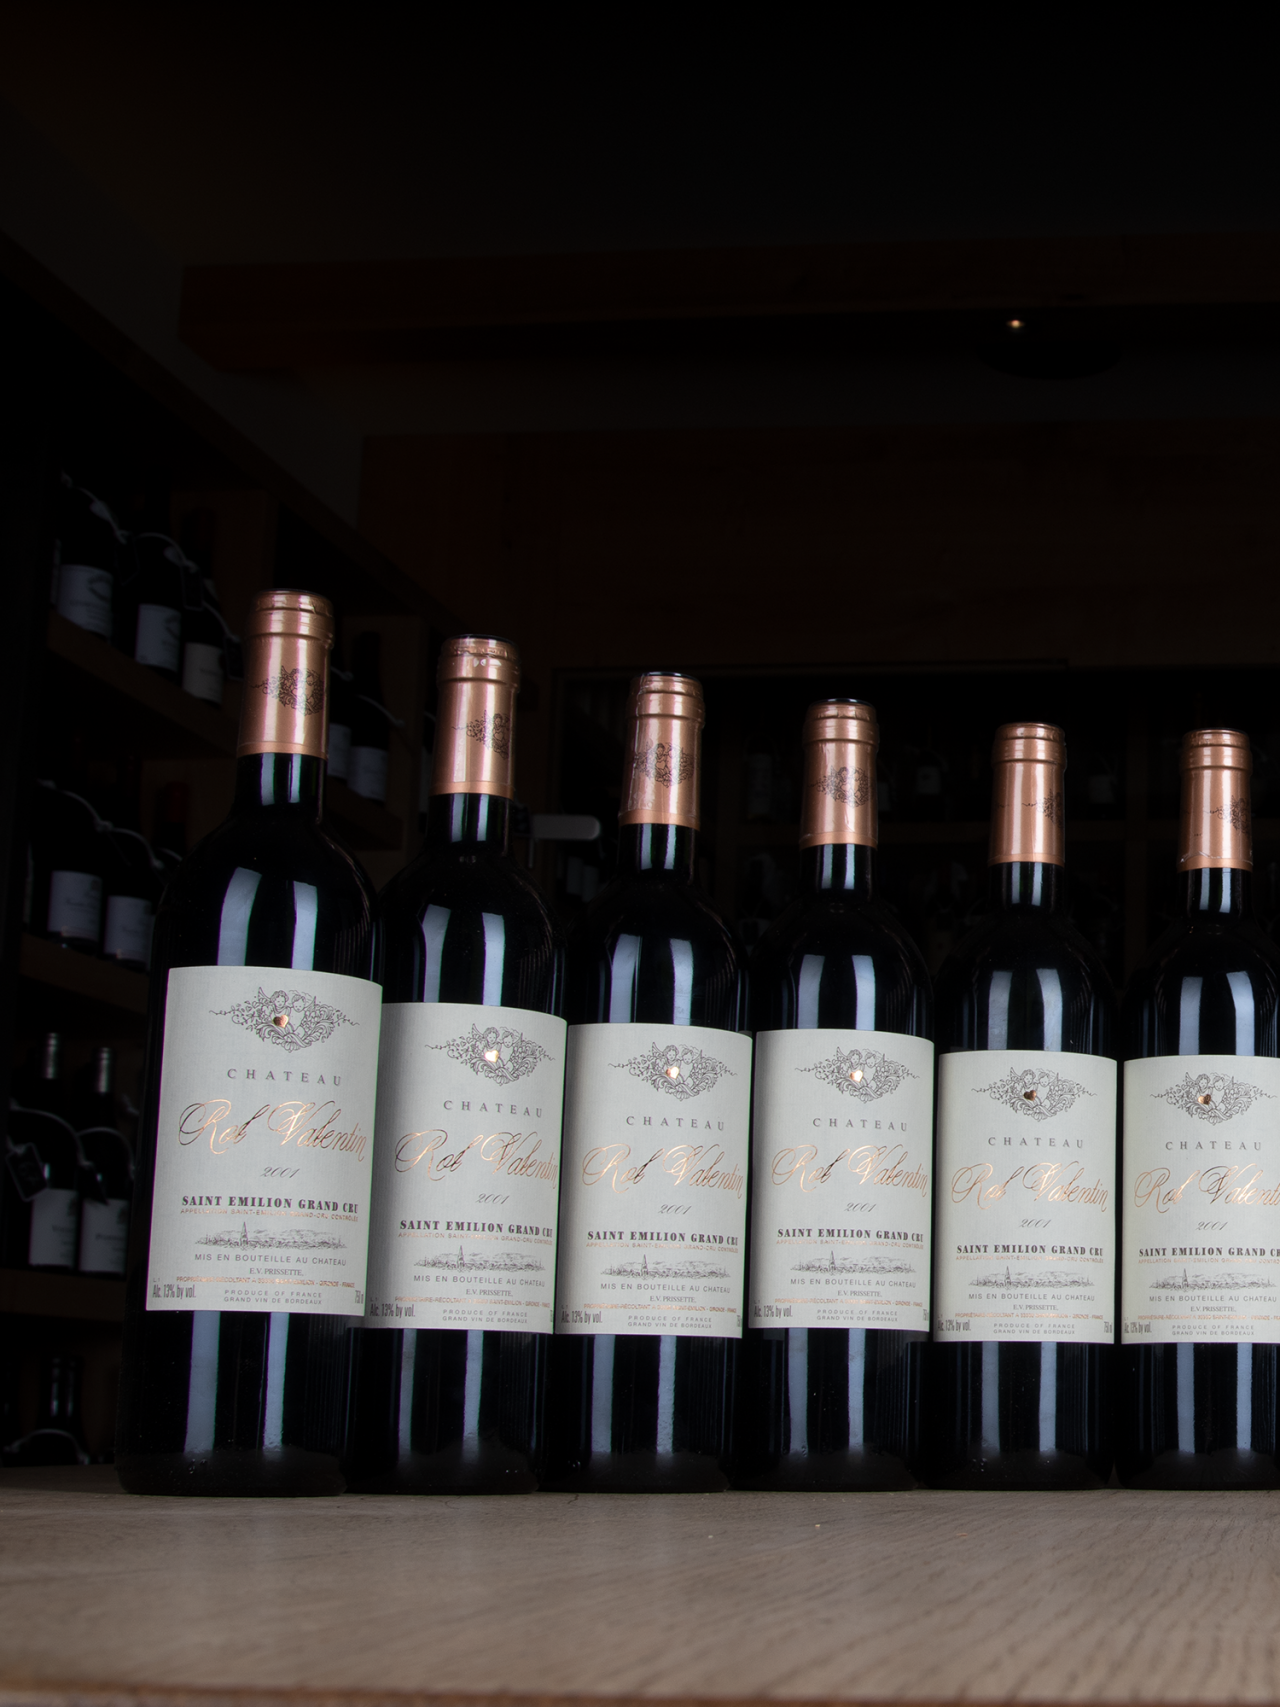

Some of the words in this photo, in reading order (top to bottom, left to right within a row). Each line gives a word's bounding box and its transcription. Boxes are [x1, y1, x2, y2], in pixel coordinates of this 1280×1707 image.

[227, 1068, 342, 1087] CHATEAU
[443, 1100, 542, 1118] CHATEAU
[626, 1116, 724, 1131] CHATEAU
[812, 1118, 908, 1132] CHATEAU
[267, 1100, 367, 1162] Valentin
[988, 1137, 1083, 1148] CHATEAU
[1165, 1141, 1261, 1151] CHATEAU
[480, 1131, 558, 1189] Valentin
[260, 1166, 300, 1179] 2001
[662, 1144, 744, 1199] Valentin
[848, 1144, 928, 1198] Valentin
[1023, 1161, 1109, 1212] Valentin
[182, 1196, 222, 1206] SAINT
[228, 1196, 293, 1208] EMILION
[298, 1199, 339, 1212] GRAND
[475, 1193, 510, 1205] 2001
[658, 1204, 692, 1215] 2001
[843, 1203, 877, 1212] 2001
[400, 1220, 440, 1230] SAINT
[446, 1221, 503, 1233] EMILION
[508, 1224, 540, 1236] GRAND
[1018, 1219, 1051, 1228] 2001
[1195, 1222, 1228, 1231] 2001
[587, 1231, 624, 1240] SAINT
[630, 1231, 686, 1242] EMILION
[691, 1234, 724, 1244] GRAND
[777, 1228, 812, 1238] SAINT
[818, 1229, 871, 1239] EMILION
[876, 1231, 908, 1241] GRAND
[956, 1245, 988, 1253] SAINT
[994, 1245, 1046, 1254] EMILION
[1051, 1245, 1086, 1255] GRAND
[1139, 1248, 1167, 1258] SAINT
[1172, 1248, 1222, 1256] EMILION
[1228, 1248, 1266, 1257] GRAND
[195, 1253, 212, 1261] MIS
[235, 1254, 291, 1263] BOUTEILLE
[296, 1256, 308, 1264] AU
[312, 1257, 346, 1266] CHATEAU
[452, 1276, 503, 1285] BOUTEILLE
[520, 1279, 545, 1287] CHATEAU
[152, 1285, 162, 1299] Alc.
[163, 1284, 175, 1298] 13%
[176, 1286, 184, 1300] by
[185, 1285, 196, 1298] vol.
[370, 1304, 380, 1317] Alc.
[381, 1304, 394, 1317] 13%
[396, 1305, 403, 1318] by
[404, 1306, 415, 1317] vol.
